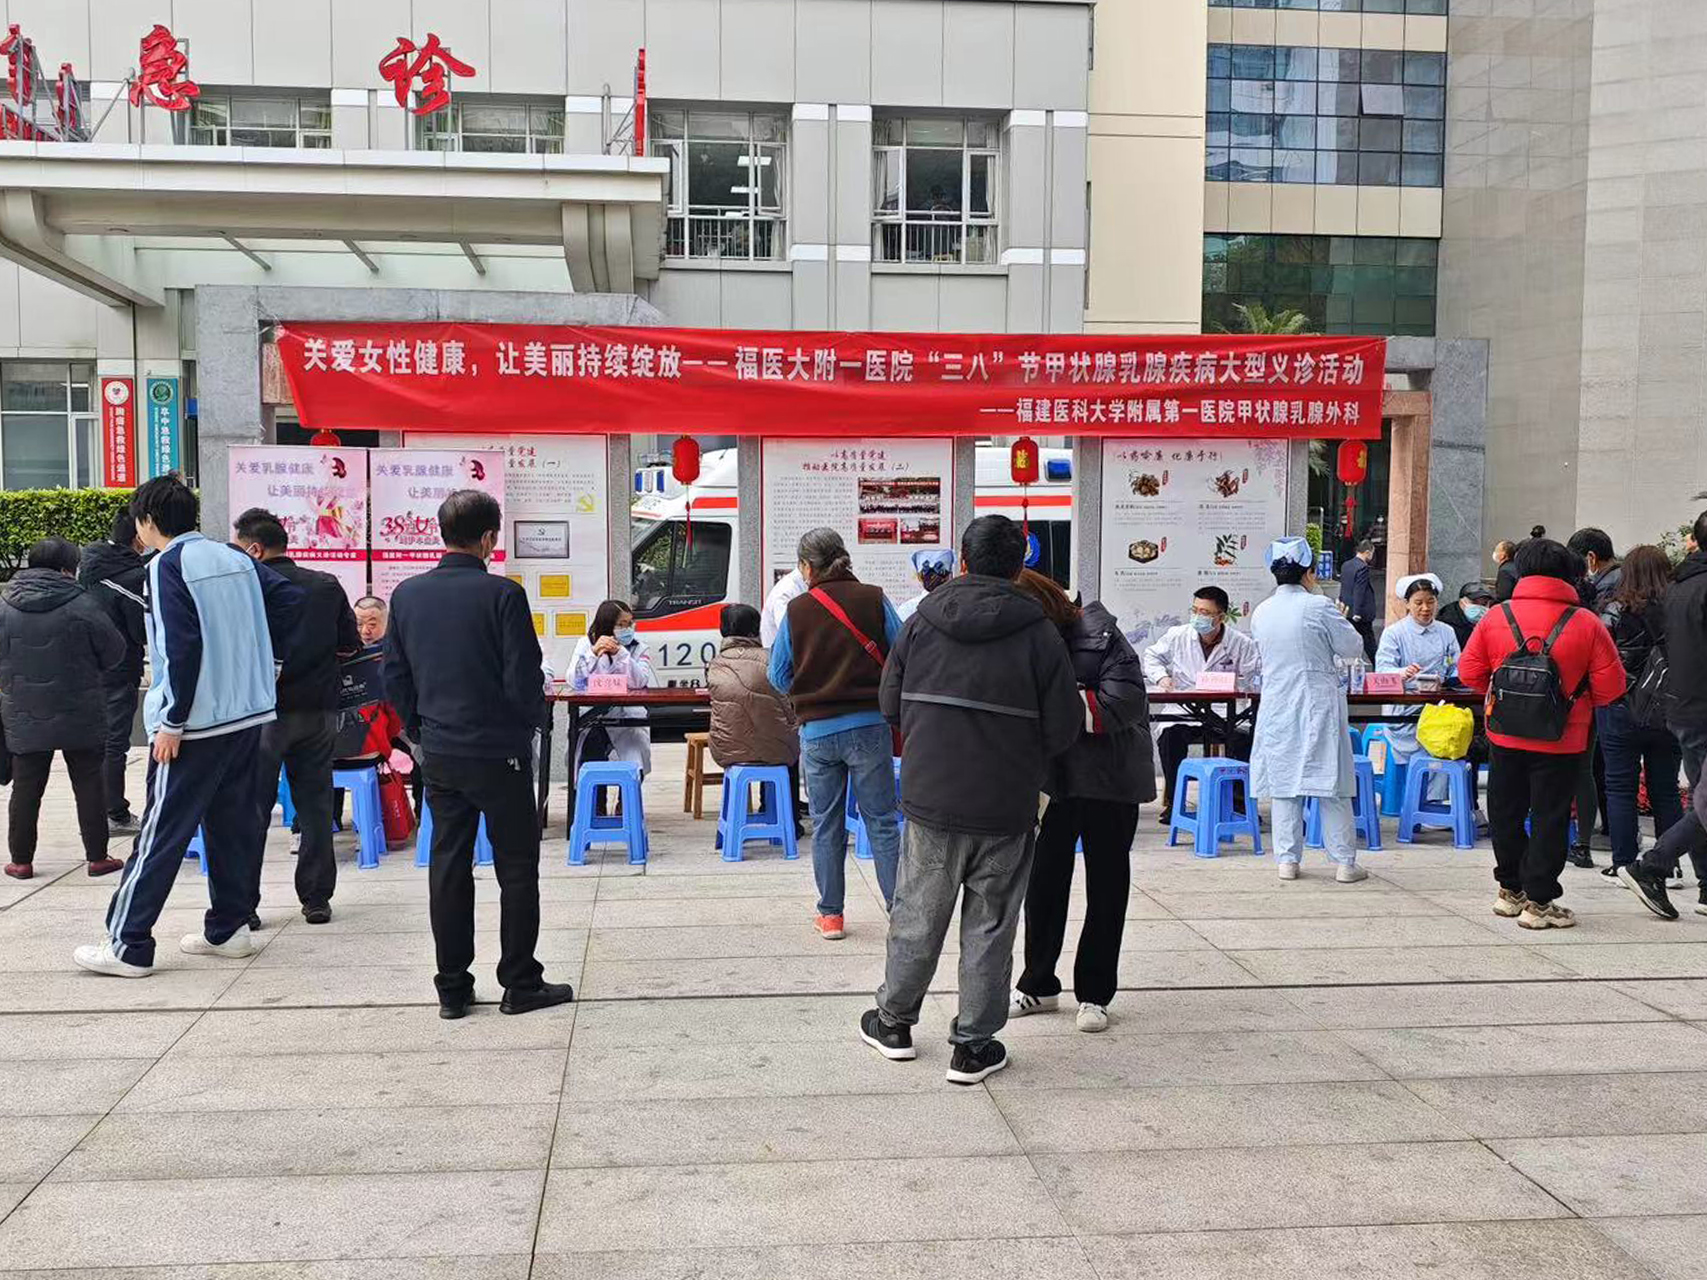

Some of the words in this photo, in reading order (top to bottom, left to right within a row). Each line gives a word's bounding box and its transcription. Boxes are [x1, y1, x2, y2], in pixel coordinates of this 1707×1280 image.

[830, 449, 887, 460] 以高质量党建
[235, 462, 315, 475] 关爱乳腺健康
[376, 464, 454, 477] 关爱乳腺健康
[658, 642, 716, 667] 120
